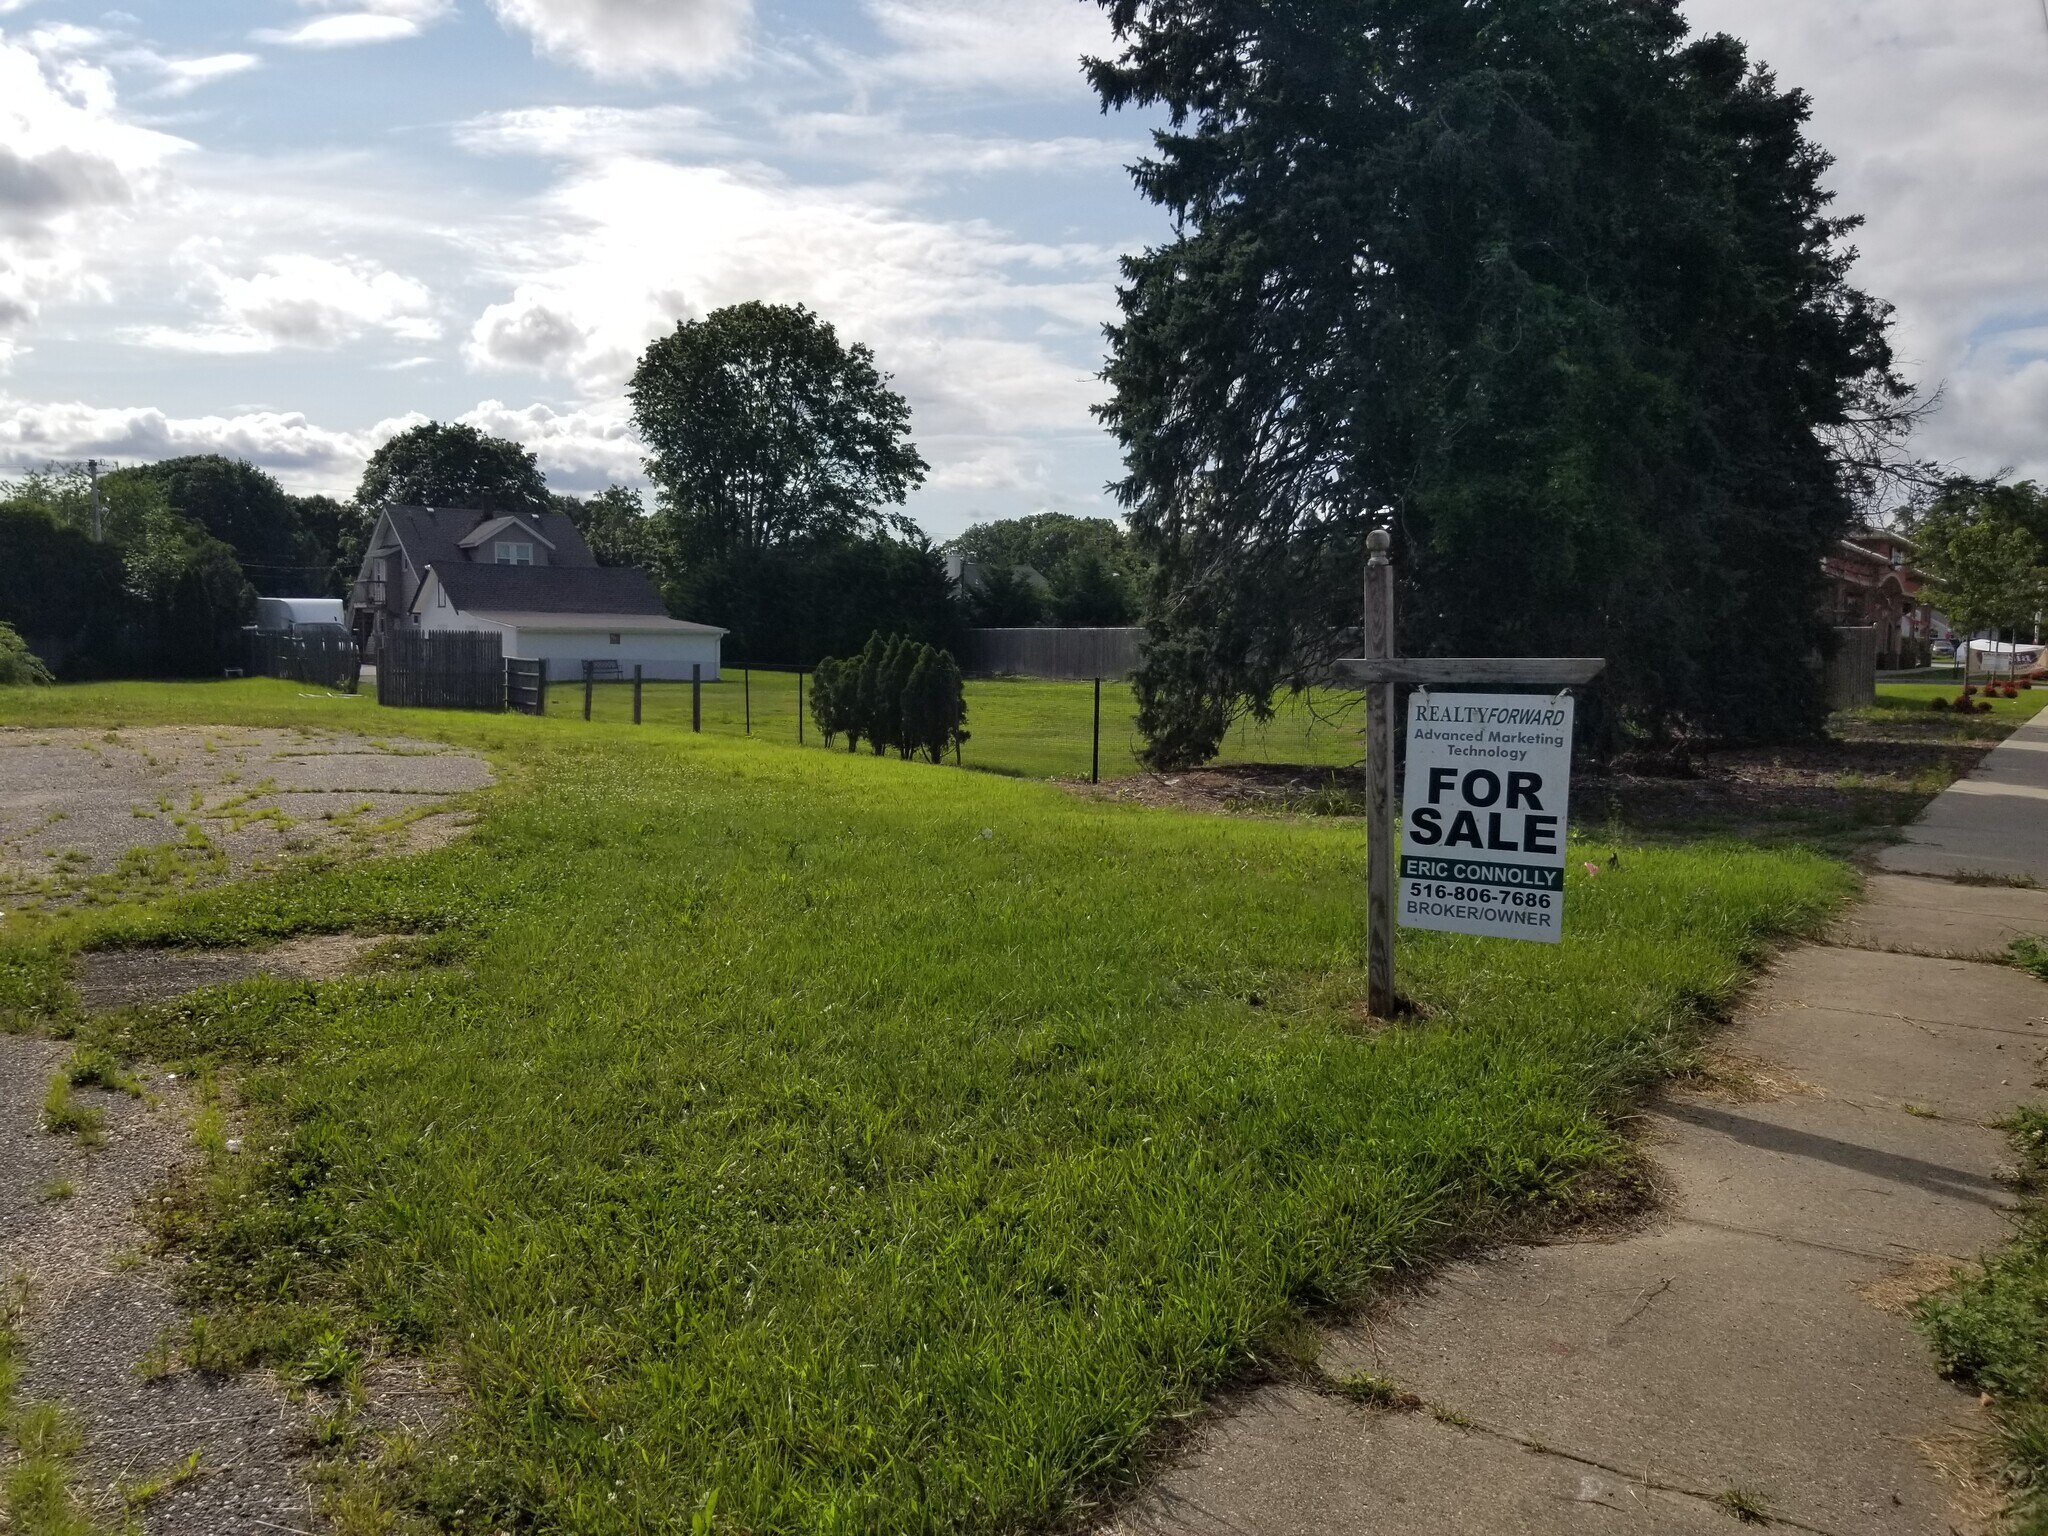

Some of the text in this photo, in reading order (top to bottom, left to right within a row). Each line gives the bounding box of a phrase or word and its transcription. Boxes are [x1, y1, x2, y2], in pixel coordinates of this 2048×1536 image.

[1415, 705, 1565, 726] REALTYFORWARD
[1414, 729, 1563, 747] Advanced Marketing
[1448, 744, 1527, 761] Technology
[1428, 767, 1544, 810] FOR
[1409, 807, 1557, 854] SALE
[1406, 860, 1556, 885] ERIC CONNOLLY
[1410, 882, 1551, 908] 516-806-7686
[1407, 900, 1551, 927] BROKER/OWNER
